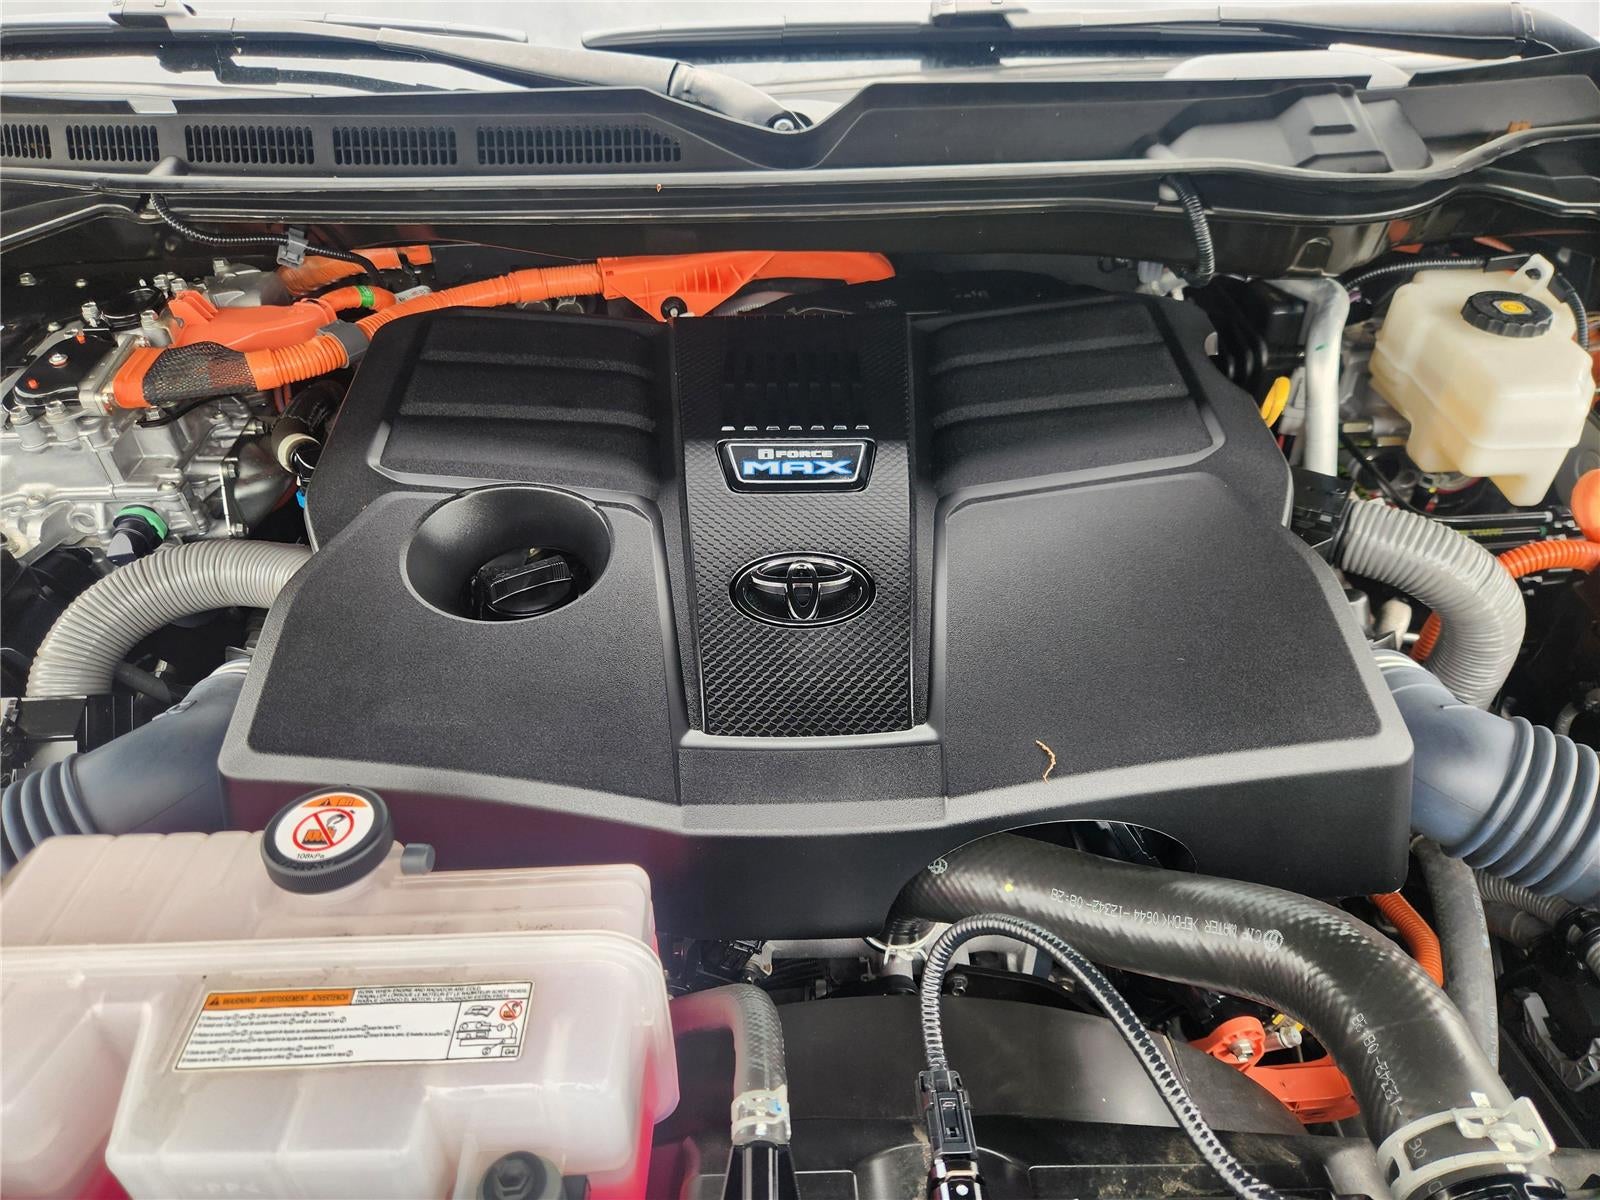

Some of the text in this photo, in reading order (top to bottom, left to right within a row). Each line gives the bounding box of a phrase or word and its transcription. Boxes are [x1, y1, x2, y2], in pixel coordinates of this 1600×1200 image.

[742, 460, 853, 476] MAX
[1134, 909, 1160, 926] 0644
[1204, 919, 1238, 938] WATER
